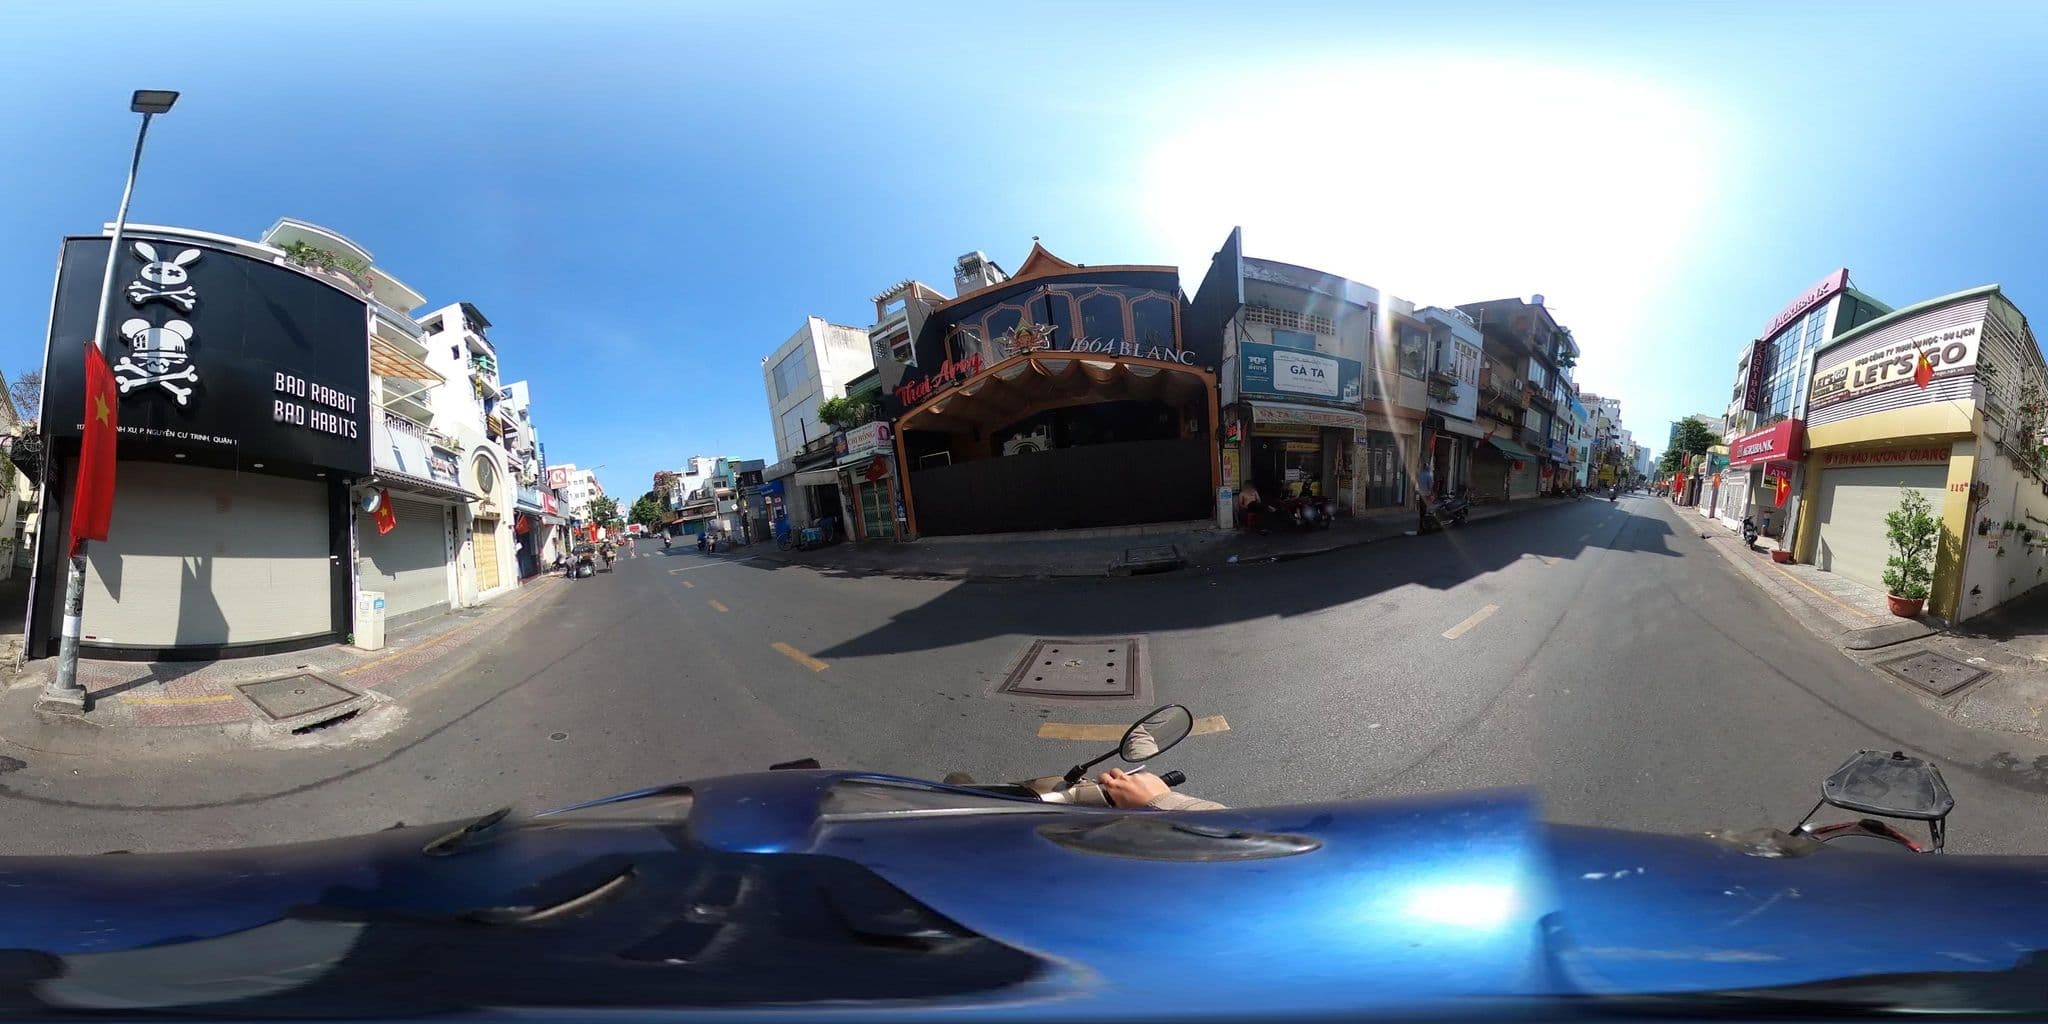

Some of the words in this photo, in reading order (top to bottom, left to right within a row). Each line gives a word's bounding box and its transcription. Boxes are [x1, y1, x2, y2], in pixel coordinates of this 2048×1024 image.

[1069, 336, 1116, 354] 1664
[1119, 341, 1196, 366] BLANC
[1886, 347, 1895, 357] TY
[1310, 367, 1325, 378] TA
[1853, 353, 1914, 388] LET'S
[1923, 342, 1967, 368] GO
[275, 371, 306, 397] BAD
[311, 382, 357, 414] RABBIT
[274, 399, 305, 426] BAD
[310, 409, 357, 439] HABITS
[1743, 439, 1775, 455] AGRIBANK
[1909, 448, 1948, 461] GIANG
[1771, 469, 1787, 477] ATM
